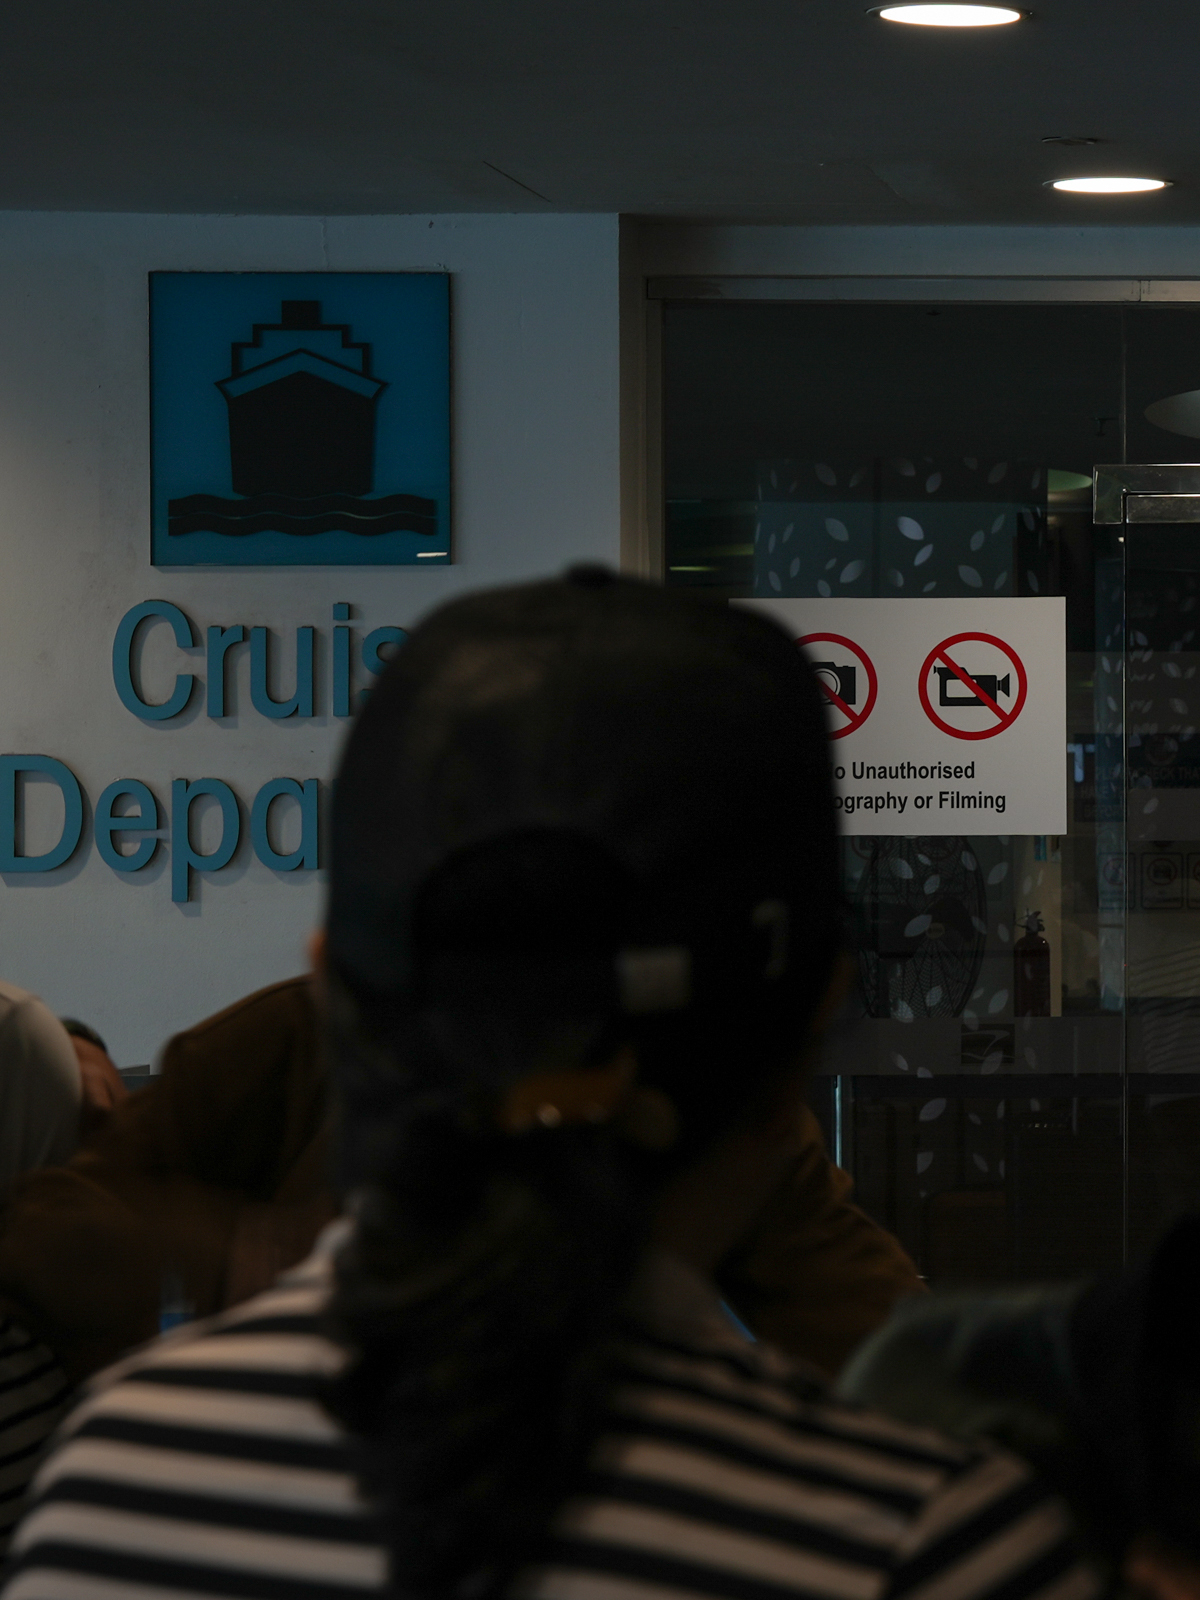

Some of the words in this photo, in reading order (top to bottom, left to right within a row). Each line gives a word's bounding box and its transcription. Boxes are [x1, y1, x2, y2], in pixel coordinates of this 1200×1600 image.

[112, 600, 409, 721] Cruis
[832, 791, 908, 814] ography
[913, 795, 933, 809] or
[939, 791, 1006, 814] Filming
[834, 766, 846, 780] o
[852, 761, 975, 780] Unauthorised
[0, 754, 339, 902] Depa
